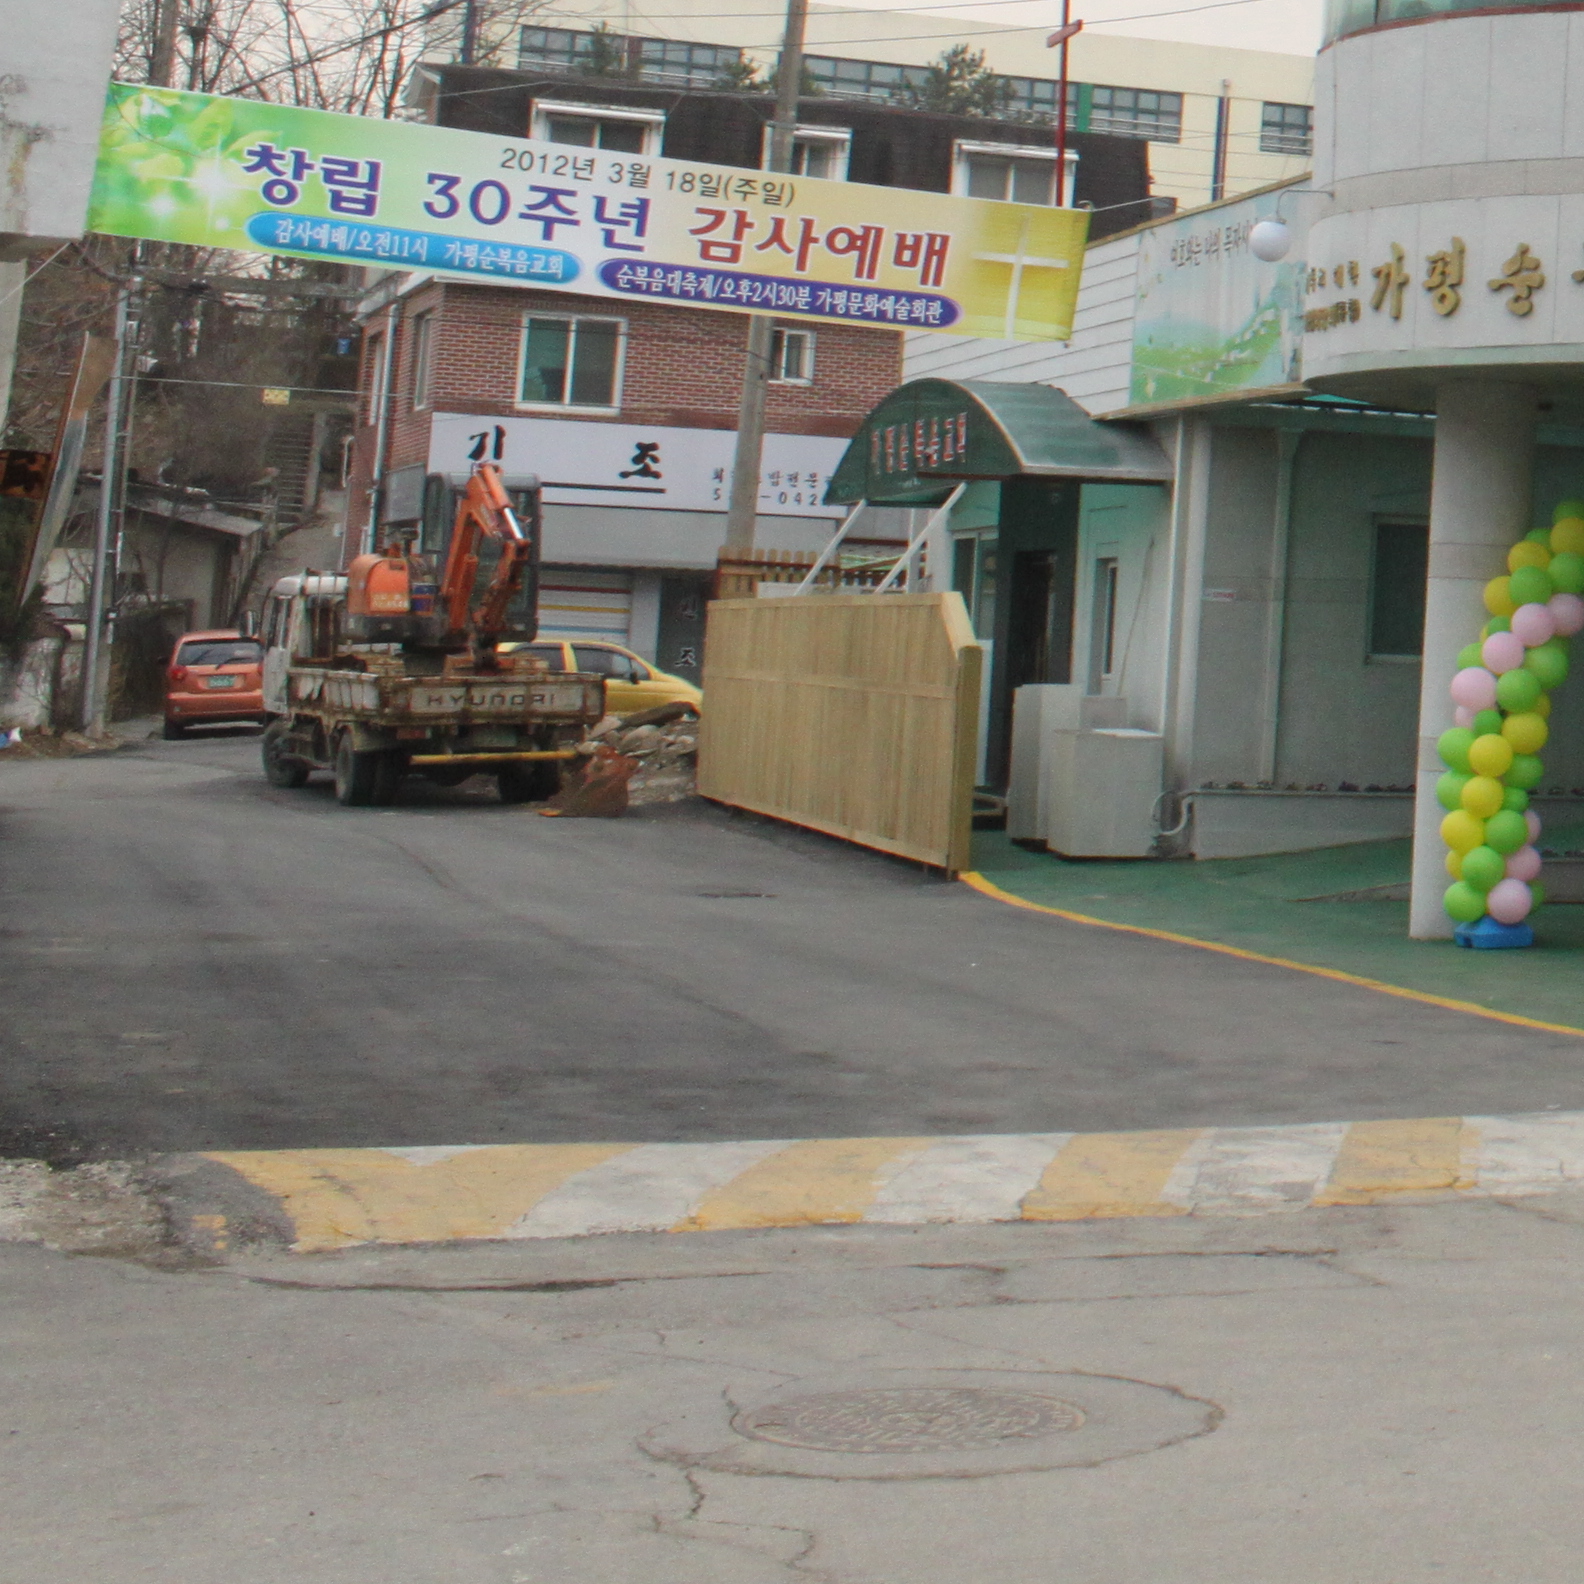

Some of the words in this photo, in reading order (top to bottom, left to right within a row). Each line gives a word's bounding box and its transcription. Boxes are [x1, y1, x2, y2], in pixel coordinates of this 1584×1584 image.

[501, 148, 596, 182] 2012년
[608, 162, 651, 189] 3월
[665, 170, 797, 207] 18일(주일)
[243, 144, 382, 217] 창립
[422, 172, 651, 253] 30주년
[688, 207, 952, 288] 감사예배
[275, 218, 429, 262] 감사예배/오전11시
[444, 241, 564, 280] 가평순복음교회
[616, 264, 813, 310] 순복음대축제/오후2시30분
[815, 287, 944, 325] 가평문화예술회관
[426, 693, 556, 707] HYUNDAI
